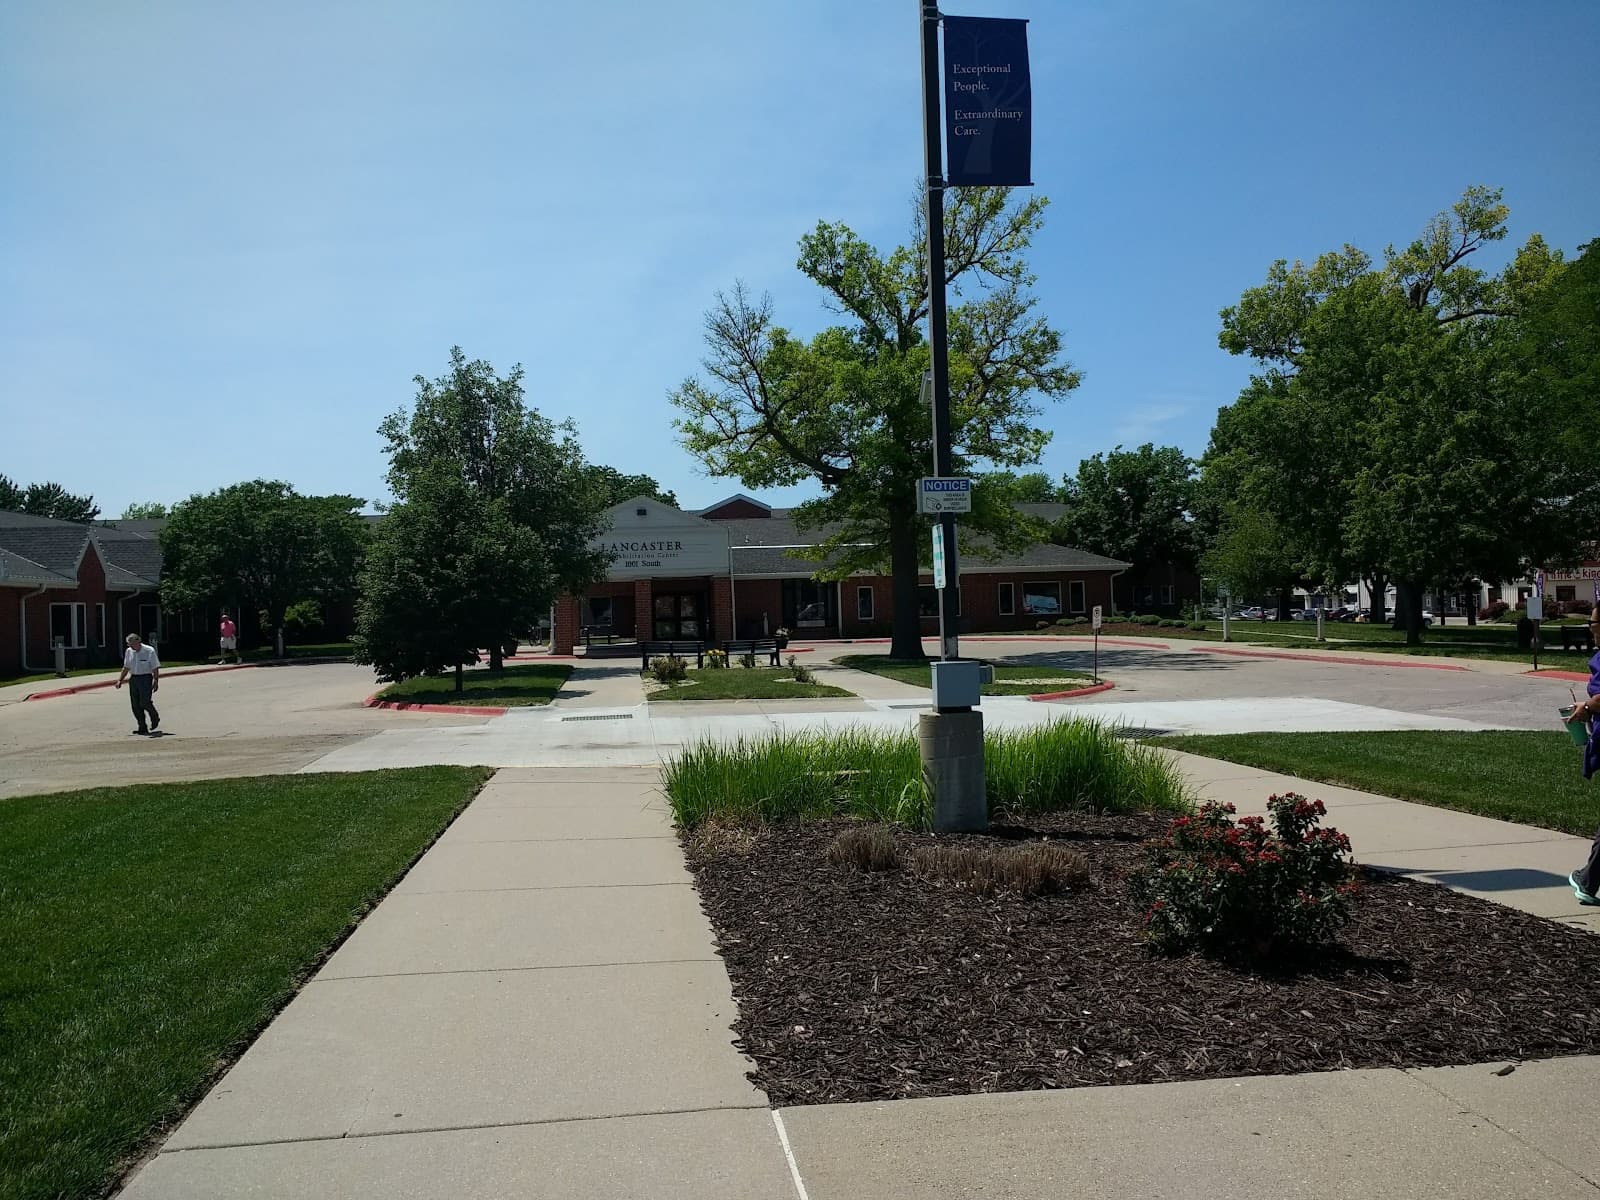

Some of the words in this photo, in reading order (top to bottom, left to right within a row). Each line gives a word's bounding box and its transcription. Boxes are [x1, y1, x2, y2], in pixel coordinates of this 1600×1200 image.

[953, 63, 1011, 76] Exceptional
[953, 81, 989, 94] People.
[954, 108, 1023, 121] Extraordinary
[954, 126, 981, 136] Care.
[926, 480, 967, 490] NOTICE
[600, 541, 682, 552] LANCASTER
